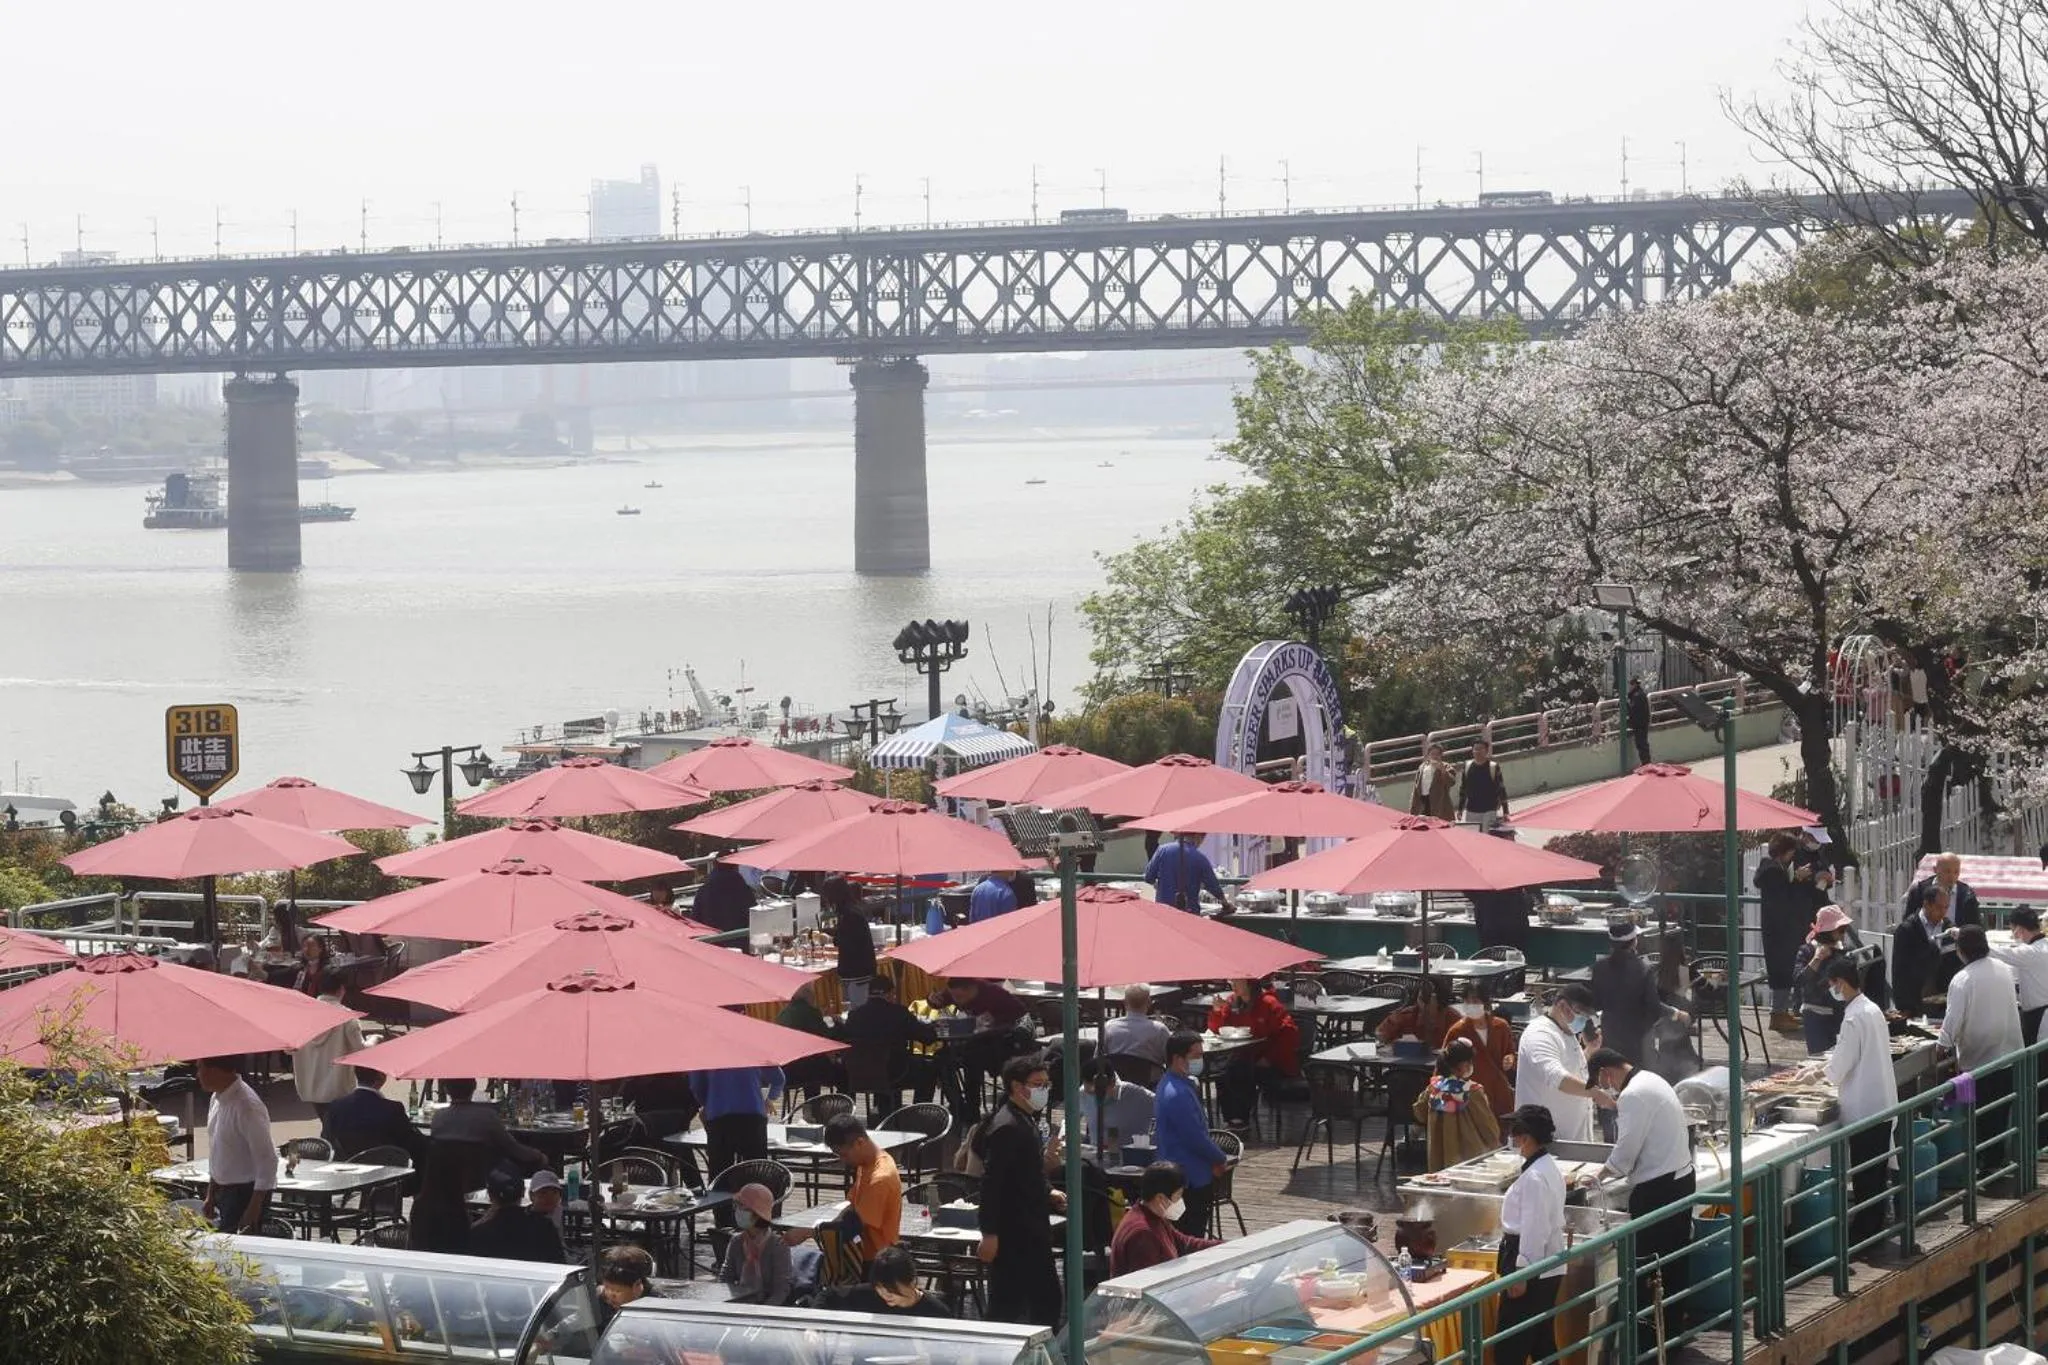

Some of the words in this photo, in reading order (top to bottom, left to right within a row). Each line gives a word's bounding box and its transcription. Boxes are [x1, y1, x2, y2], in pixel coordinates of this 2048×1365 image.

[1257, 648, 1295, 698] SPARKS
[1298, 648, 1313, 671] UP
[176, 710, 221, 733] 318
[181, 737, 226, 754] 此生
